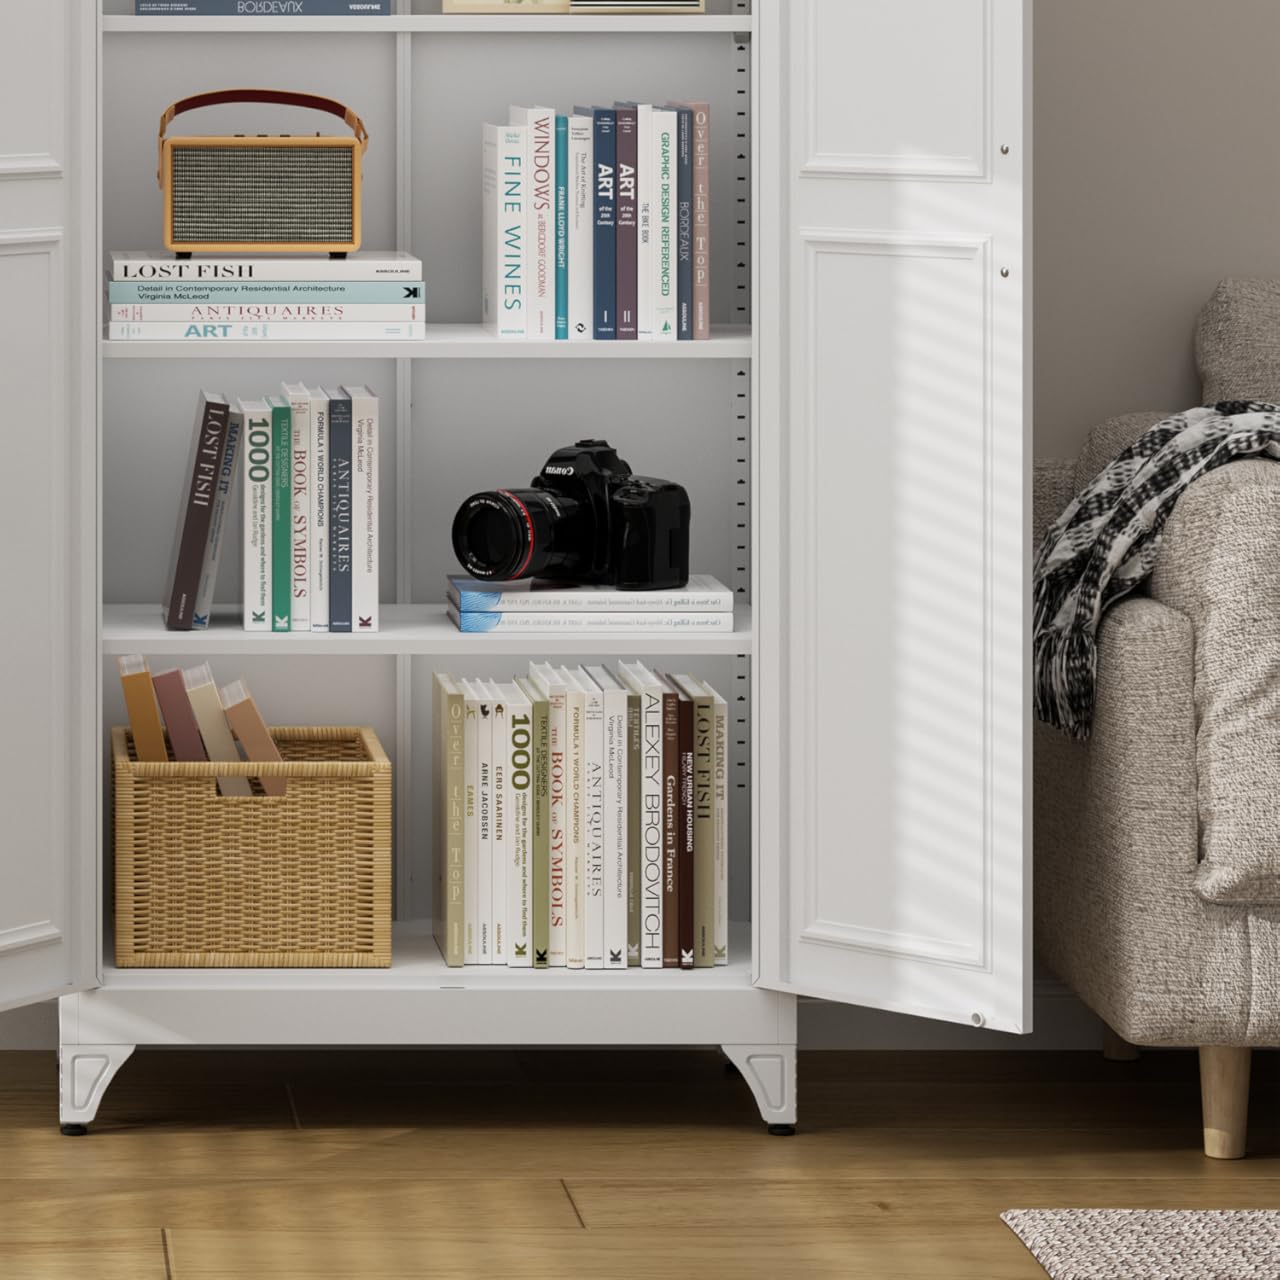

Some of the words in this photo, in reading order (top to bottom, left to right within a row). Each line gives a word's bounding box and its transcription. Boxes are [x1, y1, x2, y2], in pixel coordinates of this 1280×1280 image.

[533, 116, 550, 211] WINDOWS
[660, 132, 670, 180] GRAPHIC
[504, 157, 521, 212] FINE
[598, 164, 613, 200] ART
[619, 164, 634, 200] ART
[660, 184, 670, 223] DESIGN
[641, 203, 649, 215] THE
[679, 201, 689, 261] BORDEAUX
[641, 229, 649, 243] BOOK
[123, 265, 190, 277] LOST
[198, 265, 253, 277] FISH
[504, 225, 521, 310] WINES
[537, 258, 546, 297] GOODMAN
[660, 226, 670, 296] REFERENCED
[138, 293, 171, 301] Virginia
[175, 285, 238, 294] Contemporary
[191, 305, 344, 318] ANTIQUAIRES
[184, 325, 232, 338] ART
[203, 408, 225, 459] LOST
[222, 422, 240, 477] MAKING
[248, 418, 269, 483] 1000
[218, 477, 228, 494] IT
[294, 450, 307, 496] BOOK
[336, 458, 350, 573] ANTIQUAIRES
[294, 515, 307, 598] SYMBOLS
[511, 714, 531, 791] 1000
[541, 715, 549, 747] TEXTILE
[607, 715, 615, 745] Virginia
[645, 693, 660, 785] ALEXEY
[697, 704, 711, 762] LOST
[481, 763, 489, 787] ARNE
[495, 766, 503, 790] EERO
[541, 750, 549, 797] DESIGNERS
[551, 752, 563, 807] BOOK
[481, 790, 489, 840] JACOBSEN
[495, 793, 503, 841] SAARINEN
[666, 775, 676, 829] Gardens
[590, 762, 602, 897] ANTIQUAIRES
[666, 832, 676, 844] in
[551, 829, 563, 928] SYMBOLS
[645, 794, 660, 949] BRODOVITCH
[666, 848, 676, 893] France
